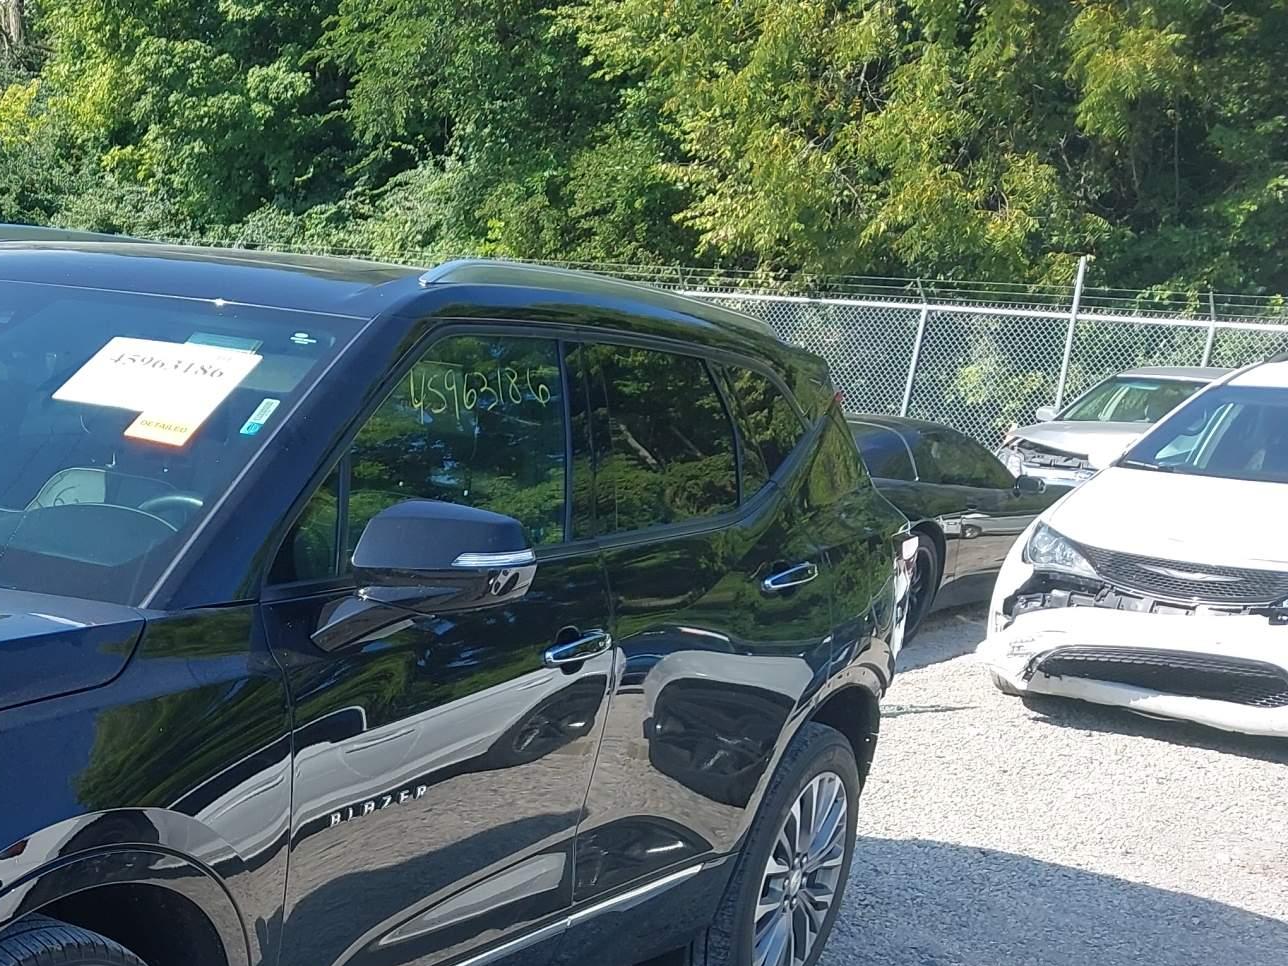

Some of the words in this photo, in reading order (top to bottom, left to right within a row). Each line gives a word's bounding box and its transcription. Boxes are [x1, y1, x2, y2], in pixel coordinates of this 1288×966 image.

[109, 352, 224, 379] 45963186
[410, 367, 551, 425] 45963186
[139, 418, 189, 434] DETAILED
[330, 785, 427, 828] BLAZER
